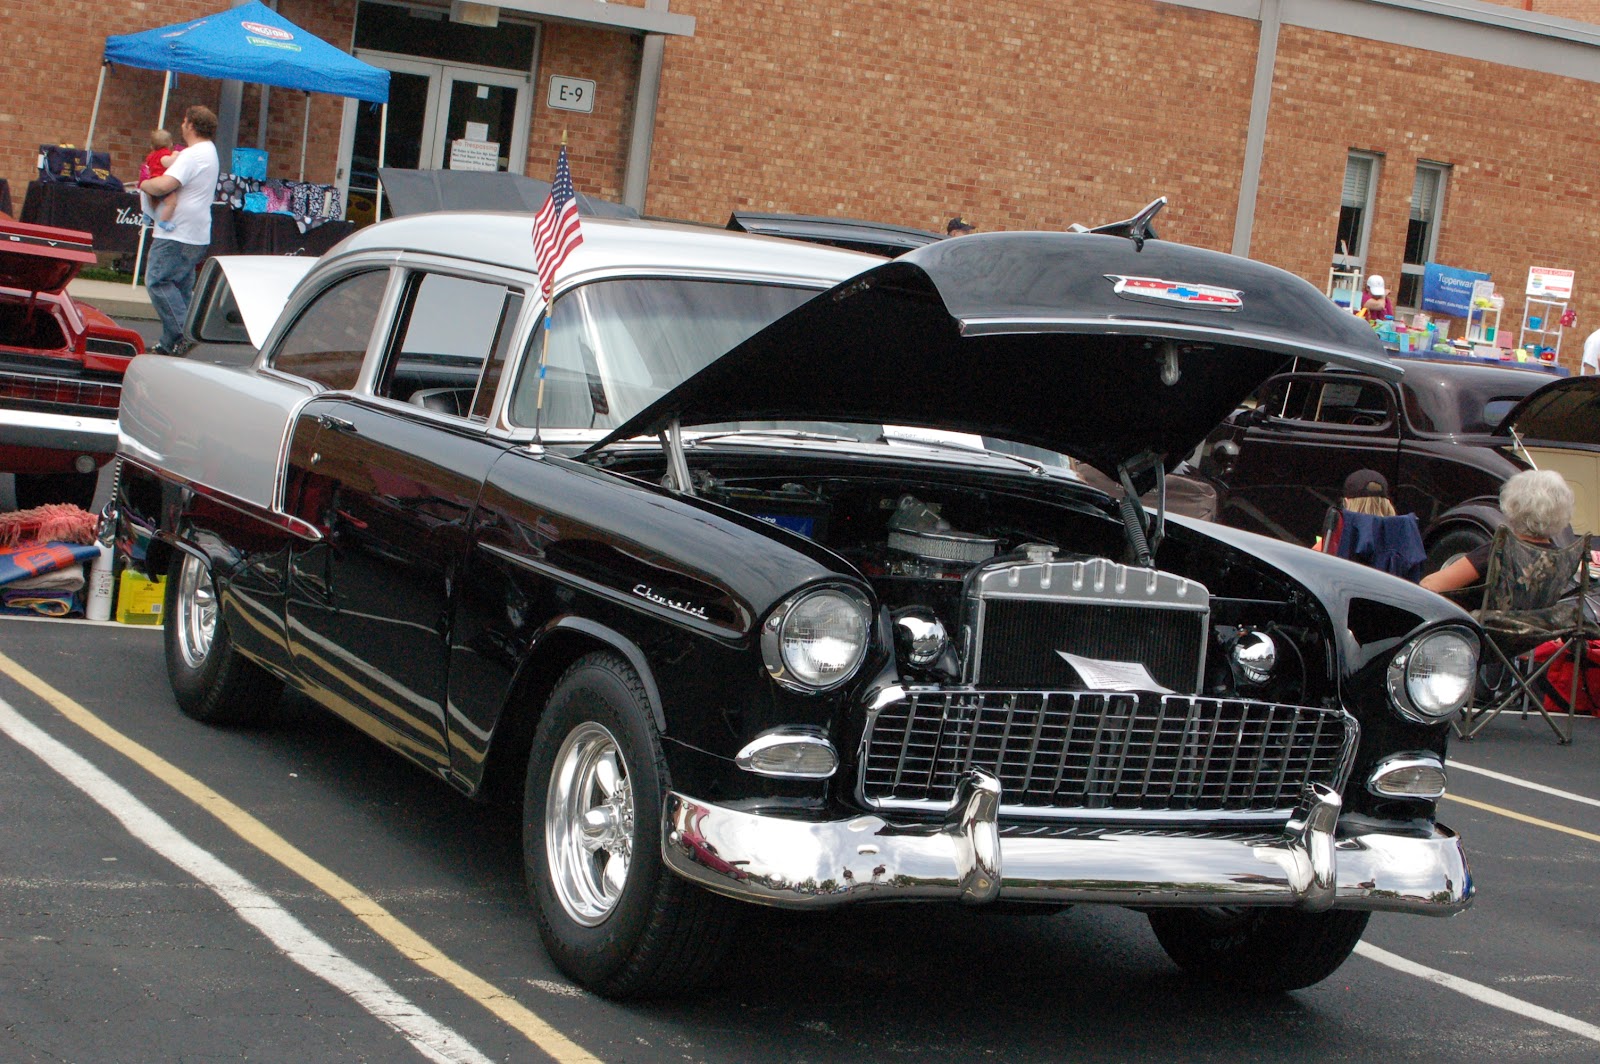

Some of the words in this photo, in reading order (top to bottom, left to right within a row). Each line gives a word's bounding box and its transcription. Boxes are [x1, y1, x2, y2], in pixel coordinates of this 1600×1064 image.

[559, 84, 583, 103] E-9
[464, 142, 498, 153] Trespassing
[1438, 273, 1473, 288] Tupperwar
[632, 583, 710, 620] Chevrolet
